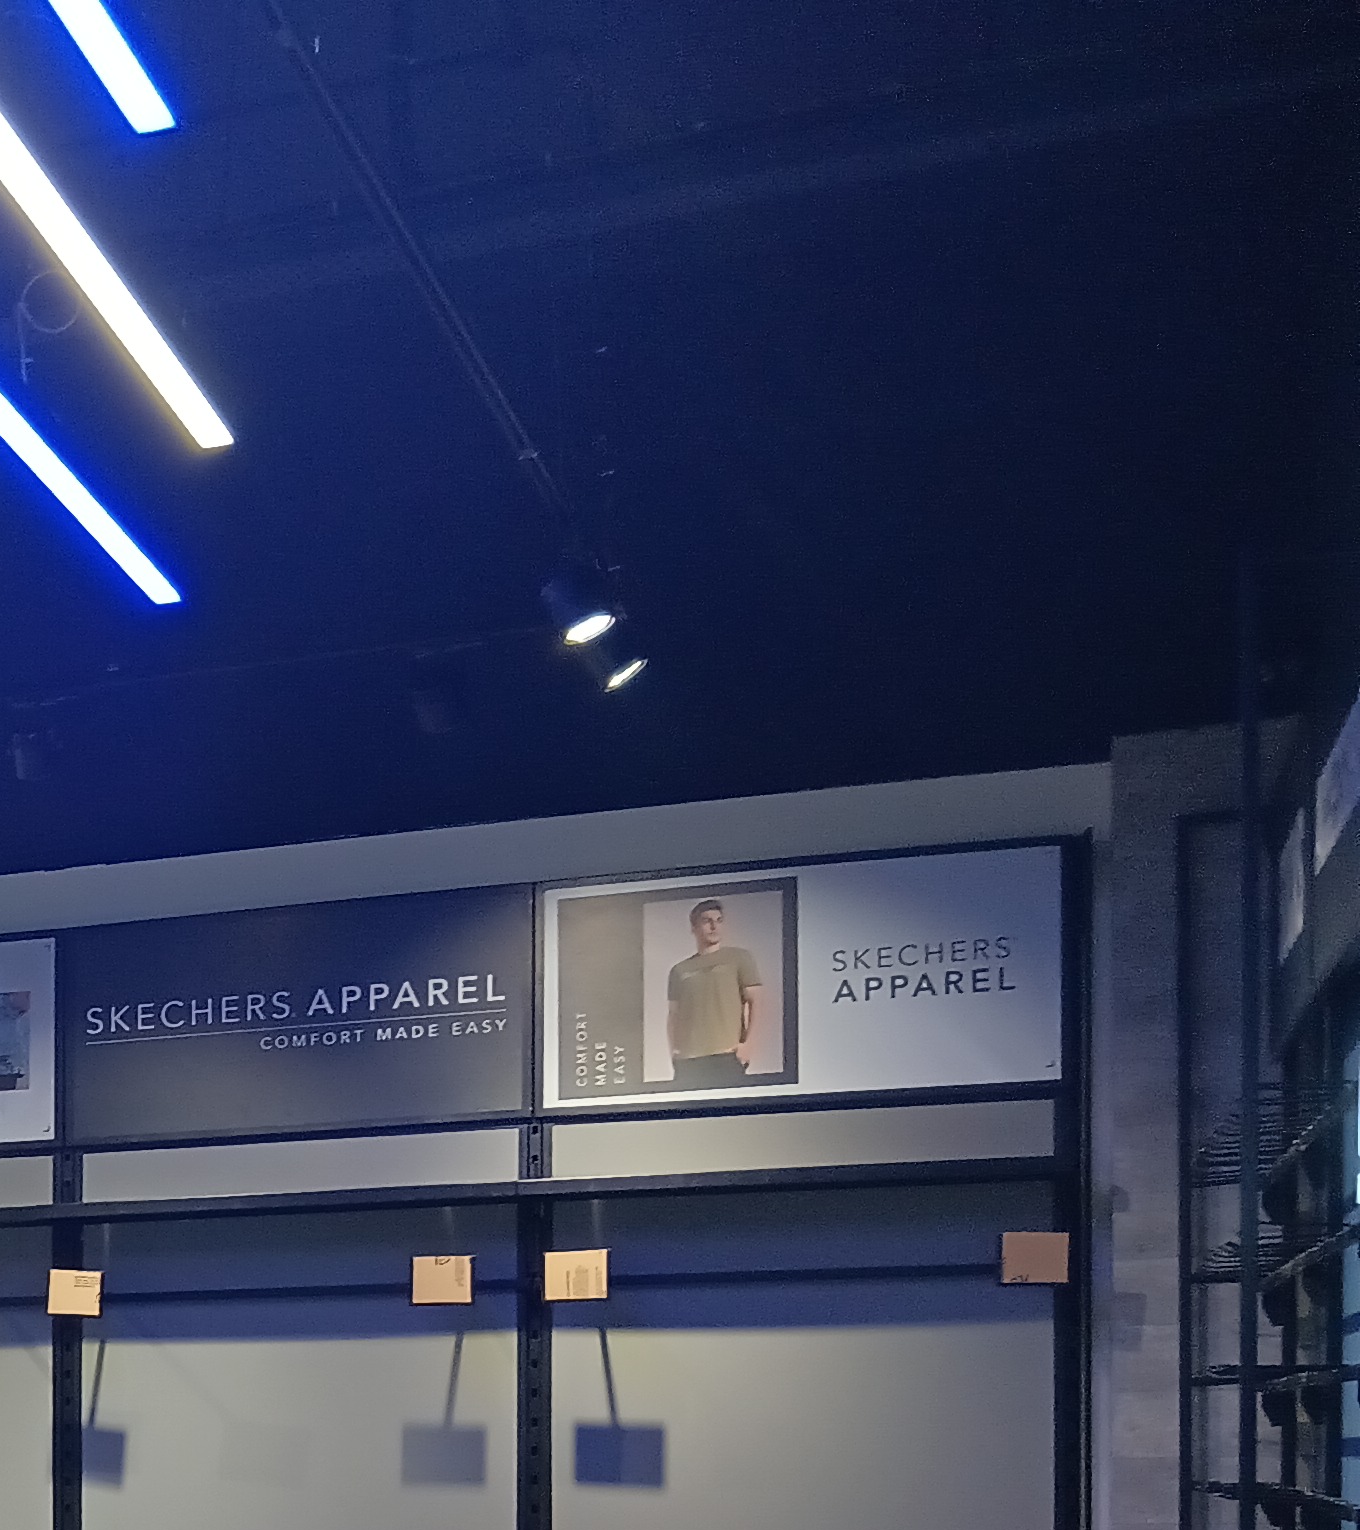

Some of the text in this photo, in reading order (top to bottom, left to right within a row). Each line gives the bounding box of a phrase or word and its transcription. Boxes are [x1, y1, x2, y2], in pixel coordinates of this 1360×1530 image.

[832, 936, 1011, 972] SKECHERS
[833, 966, 1017, 1004] APPAREL
[85, 973, 507, 1036] SKECHERS APPAREL
[259, 1017, 508, 1051] COMFORT MADE EASY
[575, 1013, 588, 1087] COMFORT
[594, 1042, 607, 1086] MADE
[613, 1046, 626, 1084] EASY
